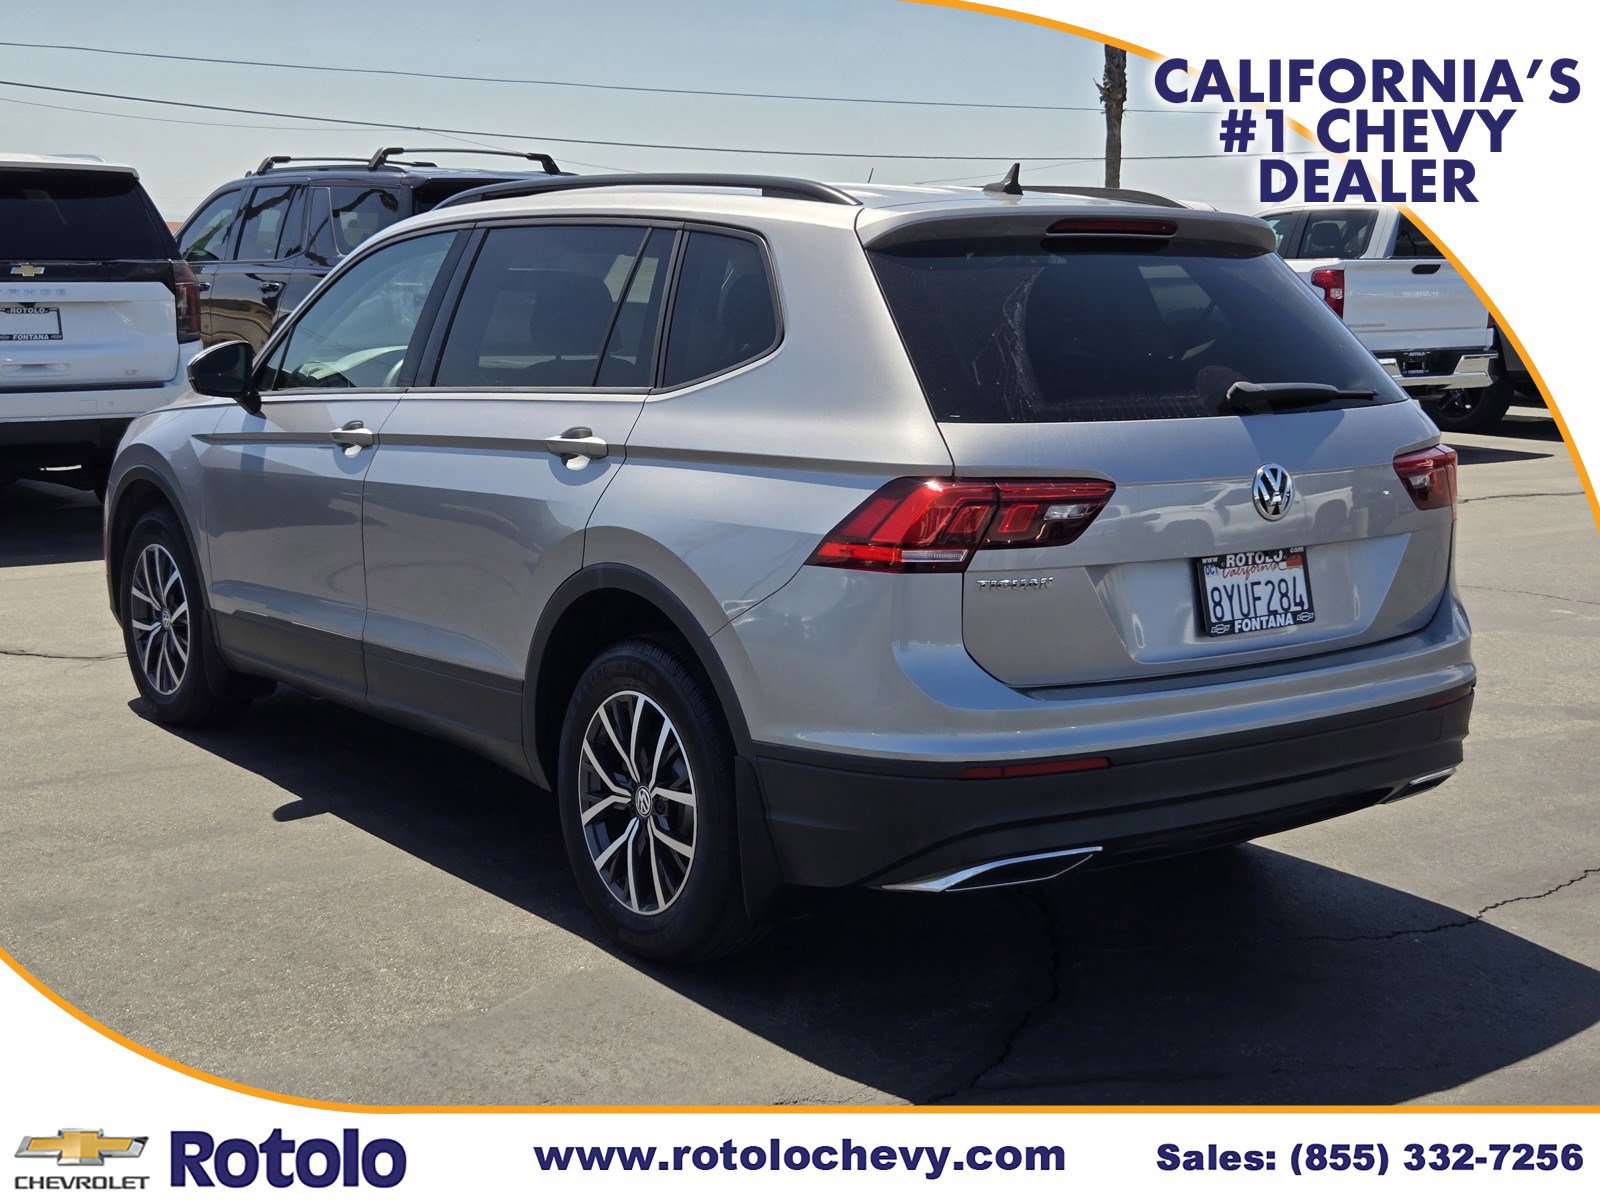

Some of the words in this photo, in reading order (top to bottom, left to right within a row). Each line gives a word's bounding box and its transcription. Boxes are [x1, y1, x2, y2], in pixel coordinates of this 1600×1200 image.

[976, 577, 1054, 592] TIGUAN
[1210, 576, 1307, 622] 8YUF284
[1234, 613, 1294, 633] FONTANA
